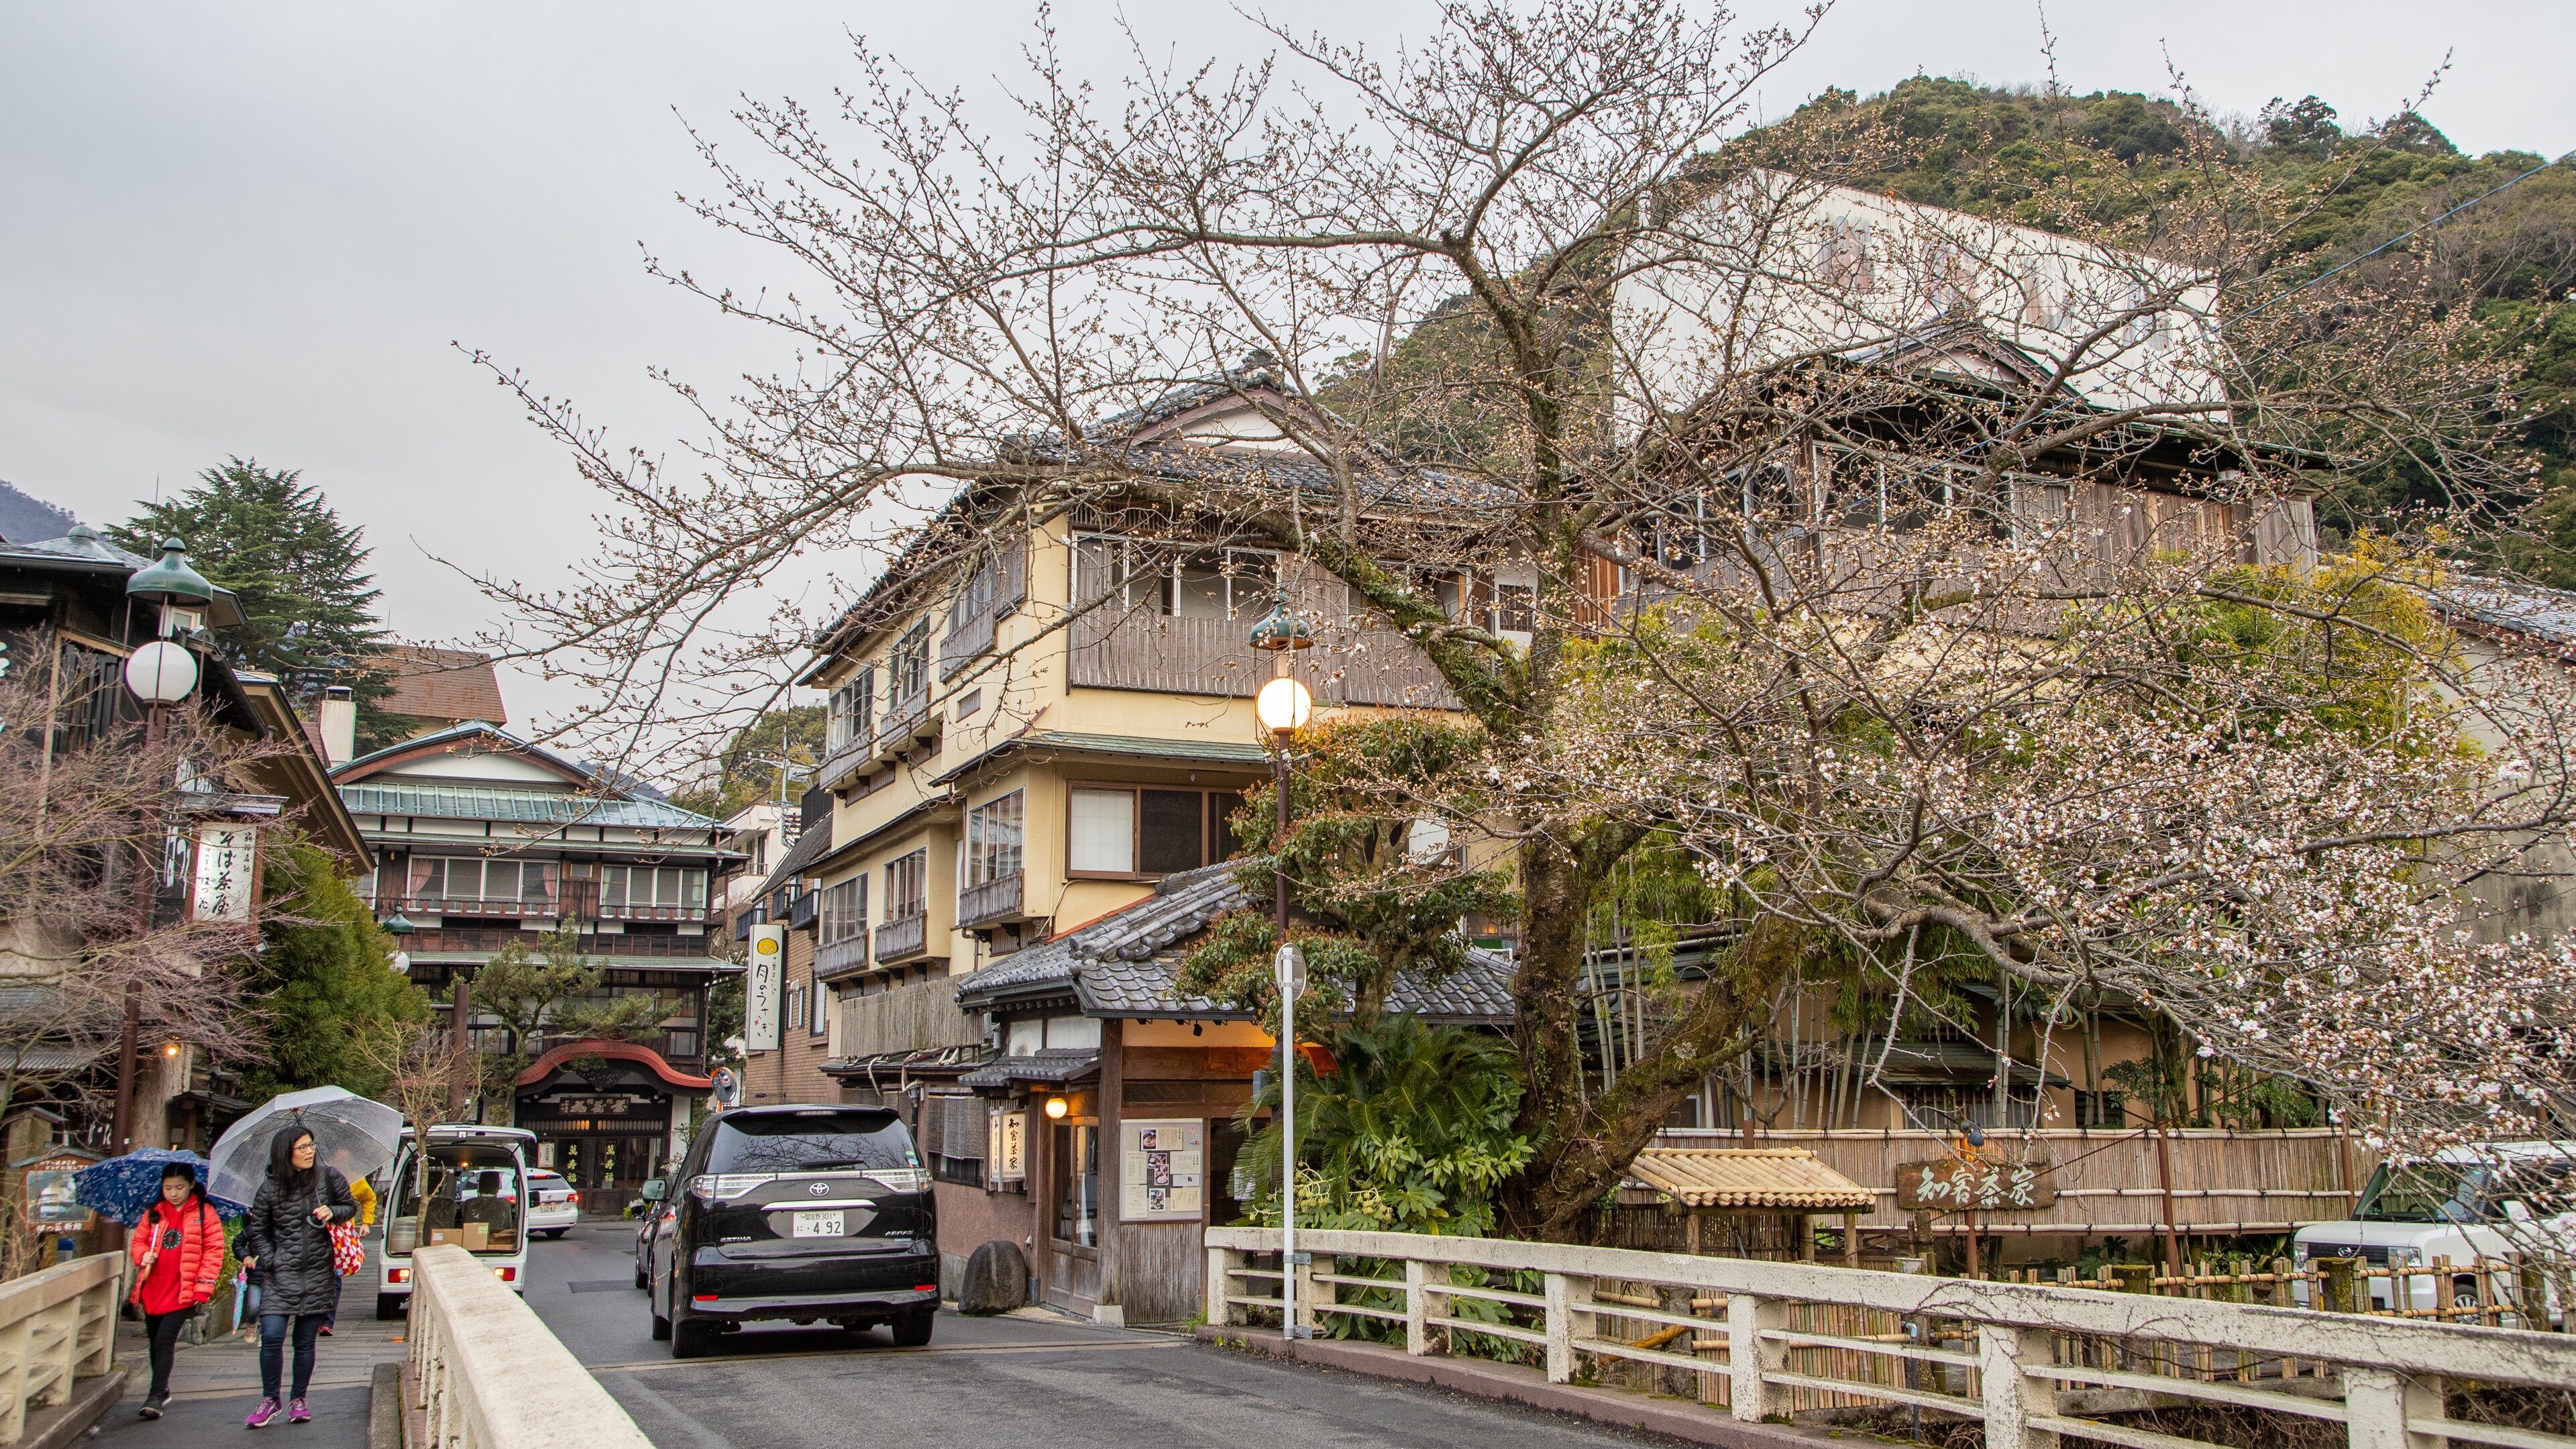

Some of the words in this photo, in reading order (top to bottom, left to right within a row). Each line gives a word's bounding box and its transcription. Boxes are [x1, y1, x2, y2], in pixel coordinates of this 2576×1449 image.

[211, 831, 237, 915] そば茶屋
[1008, 1118, 1020, 1169] 知客茶家
[1917, 1166, 2035, 1206] 知客茶家
